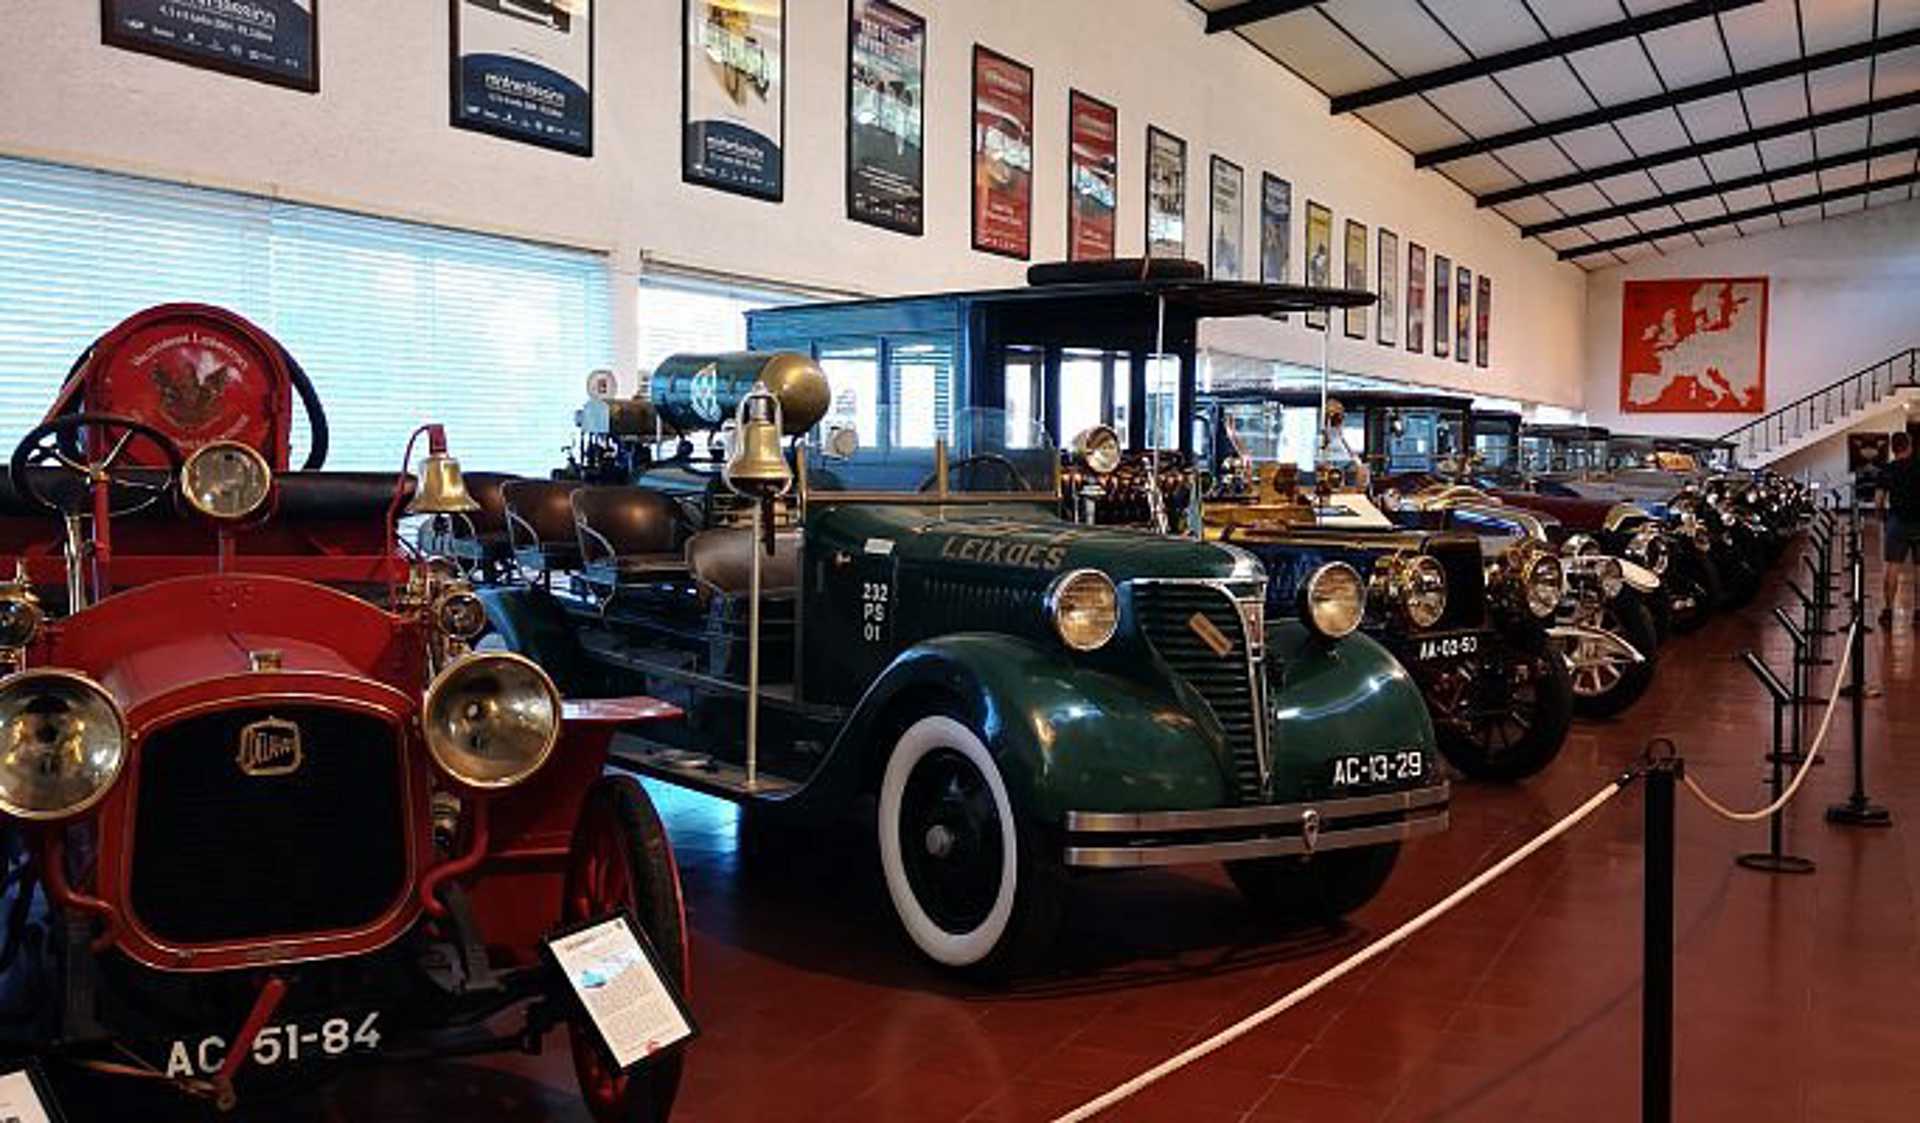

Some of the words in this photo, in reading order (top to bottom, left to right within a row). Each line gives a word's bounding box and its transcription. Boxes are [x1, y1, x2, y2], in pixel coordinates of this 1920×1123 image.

[863, 583, 888, 601] 232
[863, 604, 885, 621] PS
[1333, 752, 1422, 784] AC-13-29
